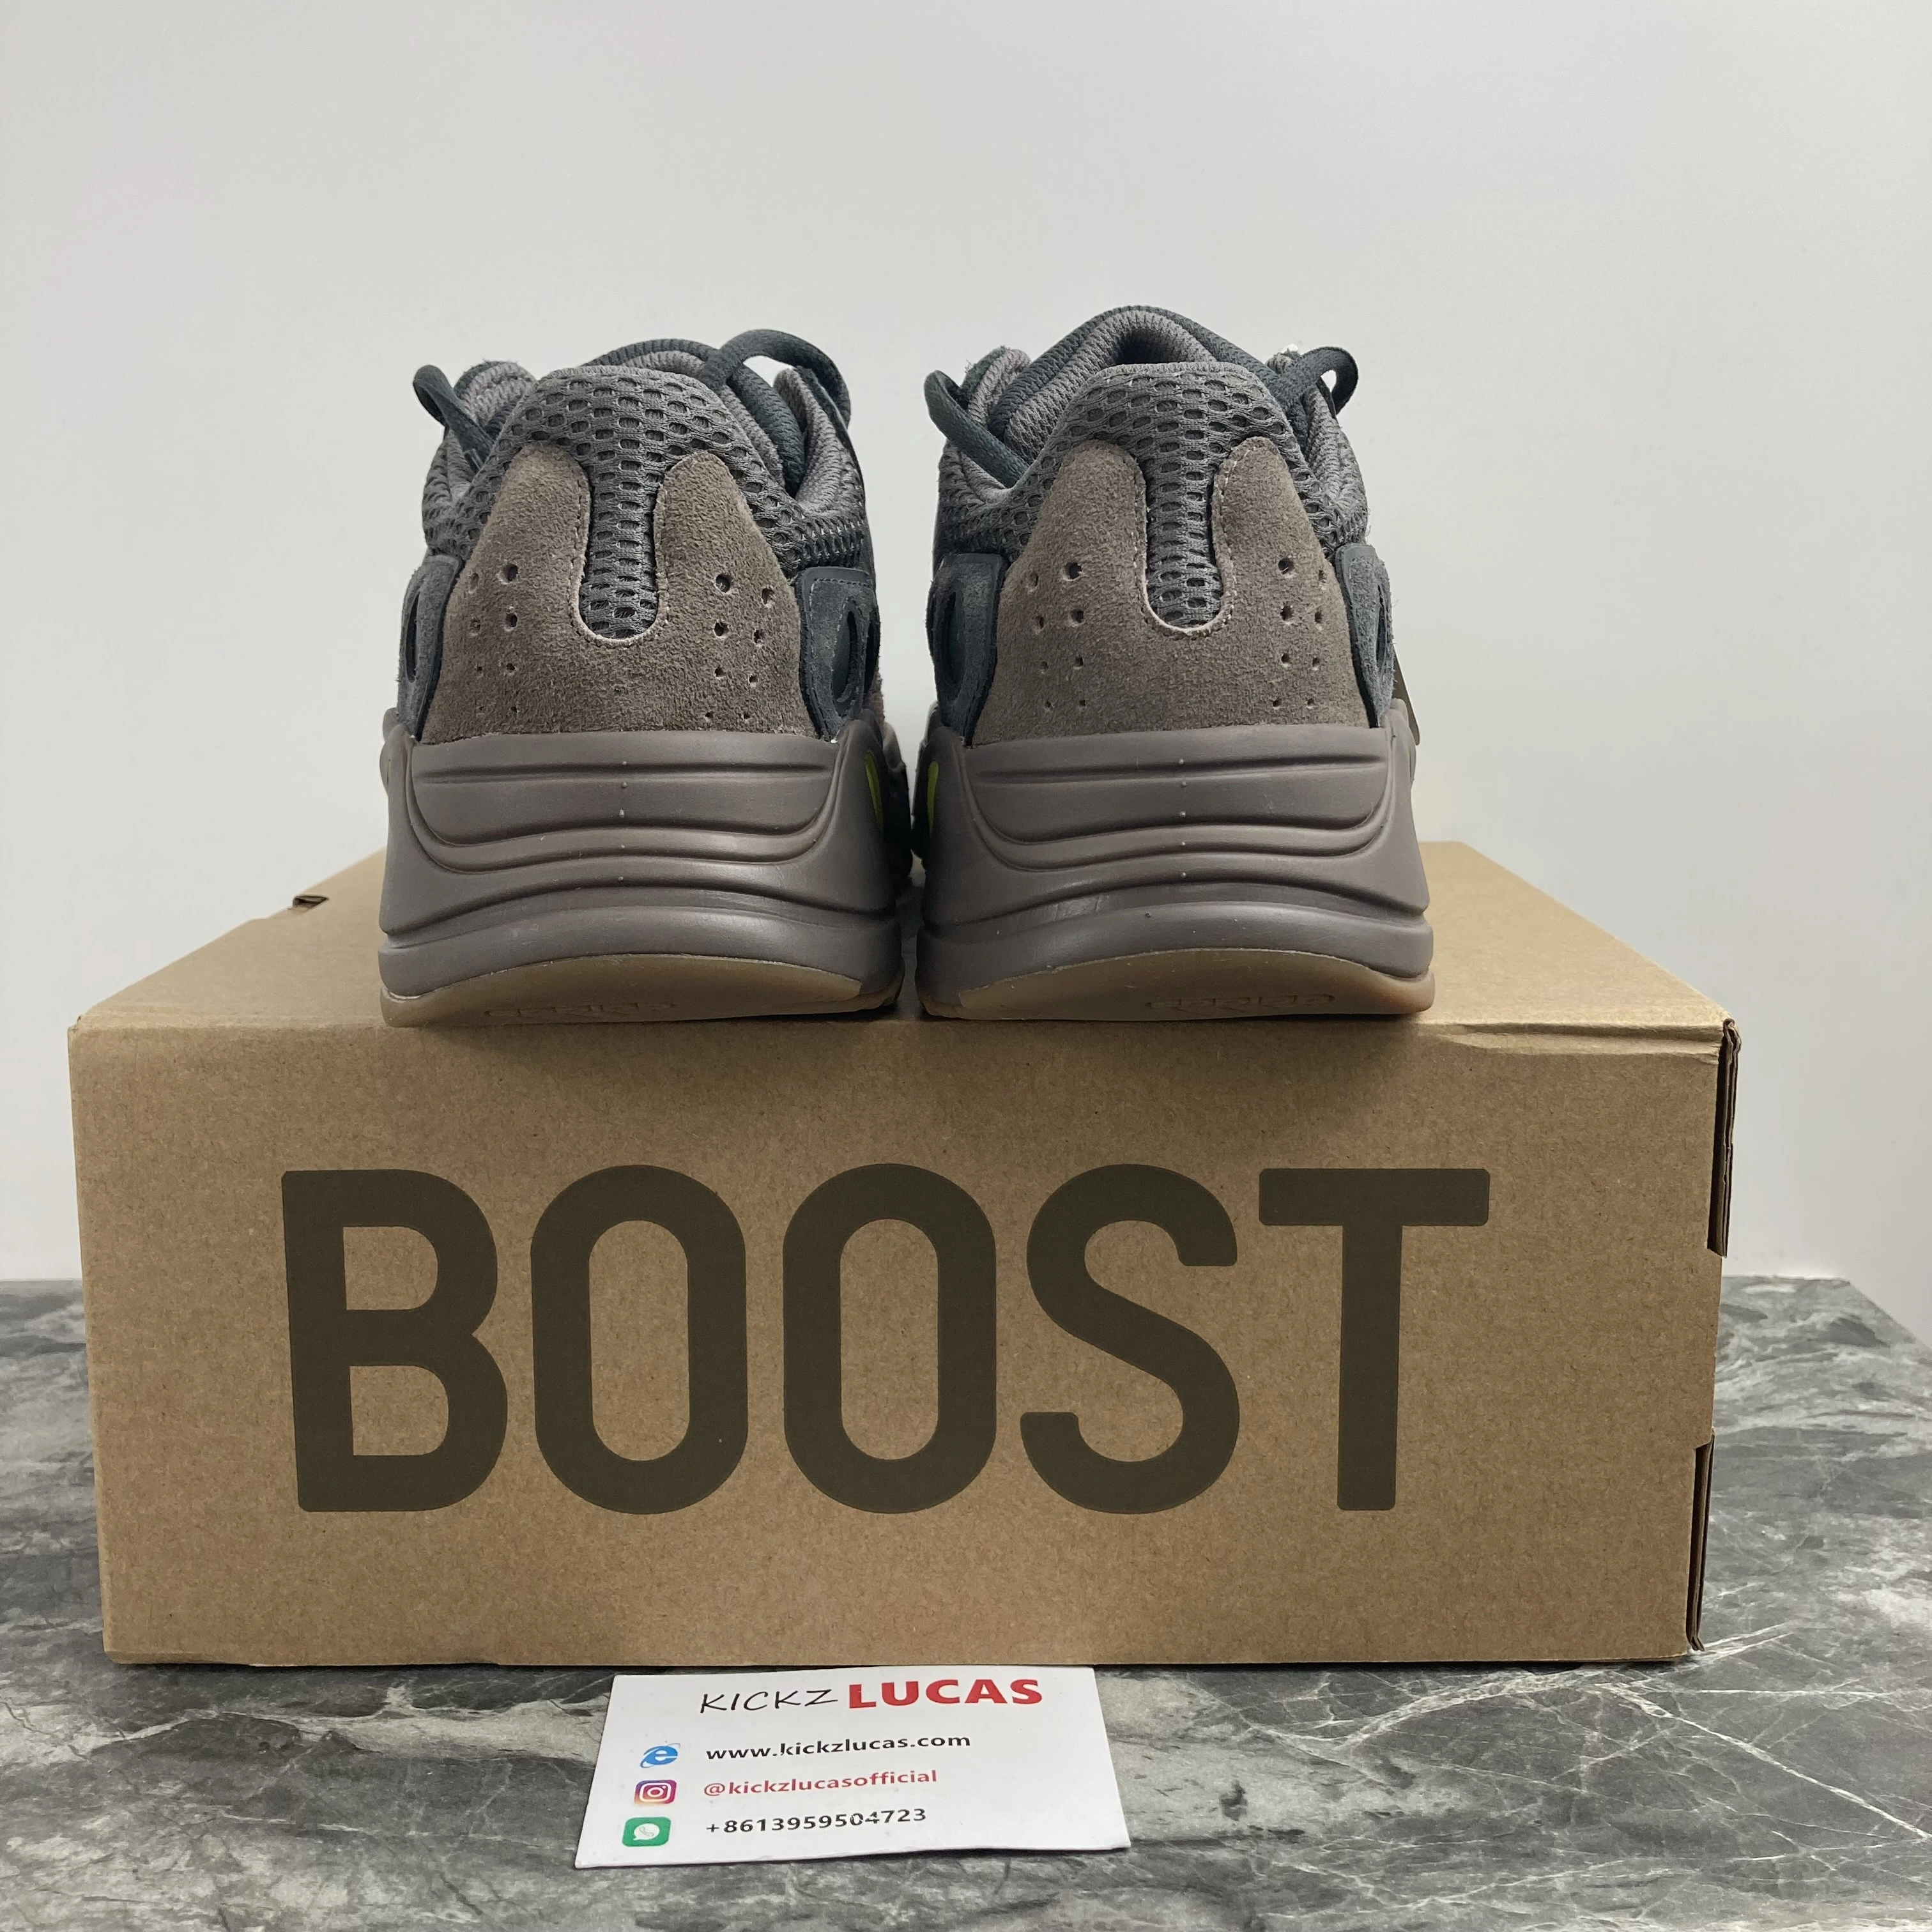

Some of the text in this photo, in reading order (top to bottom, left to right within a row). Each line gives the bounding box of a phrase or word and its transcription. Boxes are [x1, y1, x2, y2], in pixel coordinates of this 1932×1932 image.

[281, 1163, 1491, 1515] BOOST
[700, 1678, 1043, 1713] KICKZ LUCAS
[705, 1735, 971, 1759] www.kickzlucas.com
[703, 1769, 937, 1797] @kickzlucasofficial
[705, 1807, 926, 1833] +8613959504723
